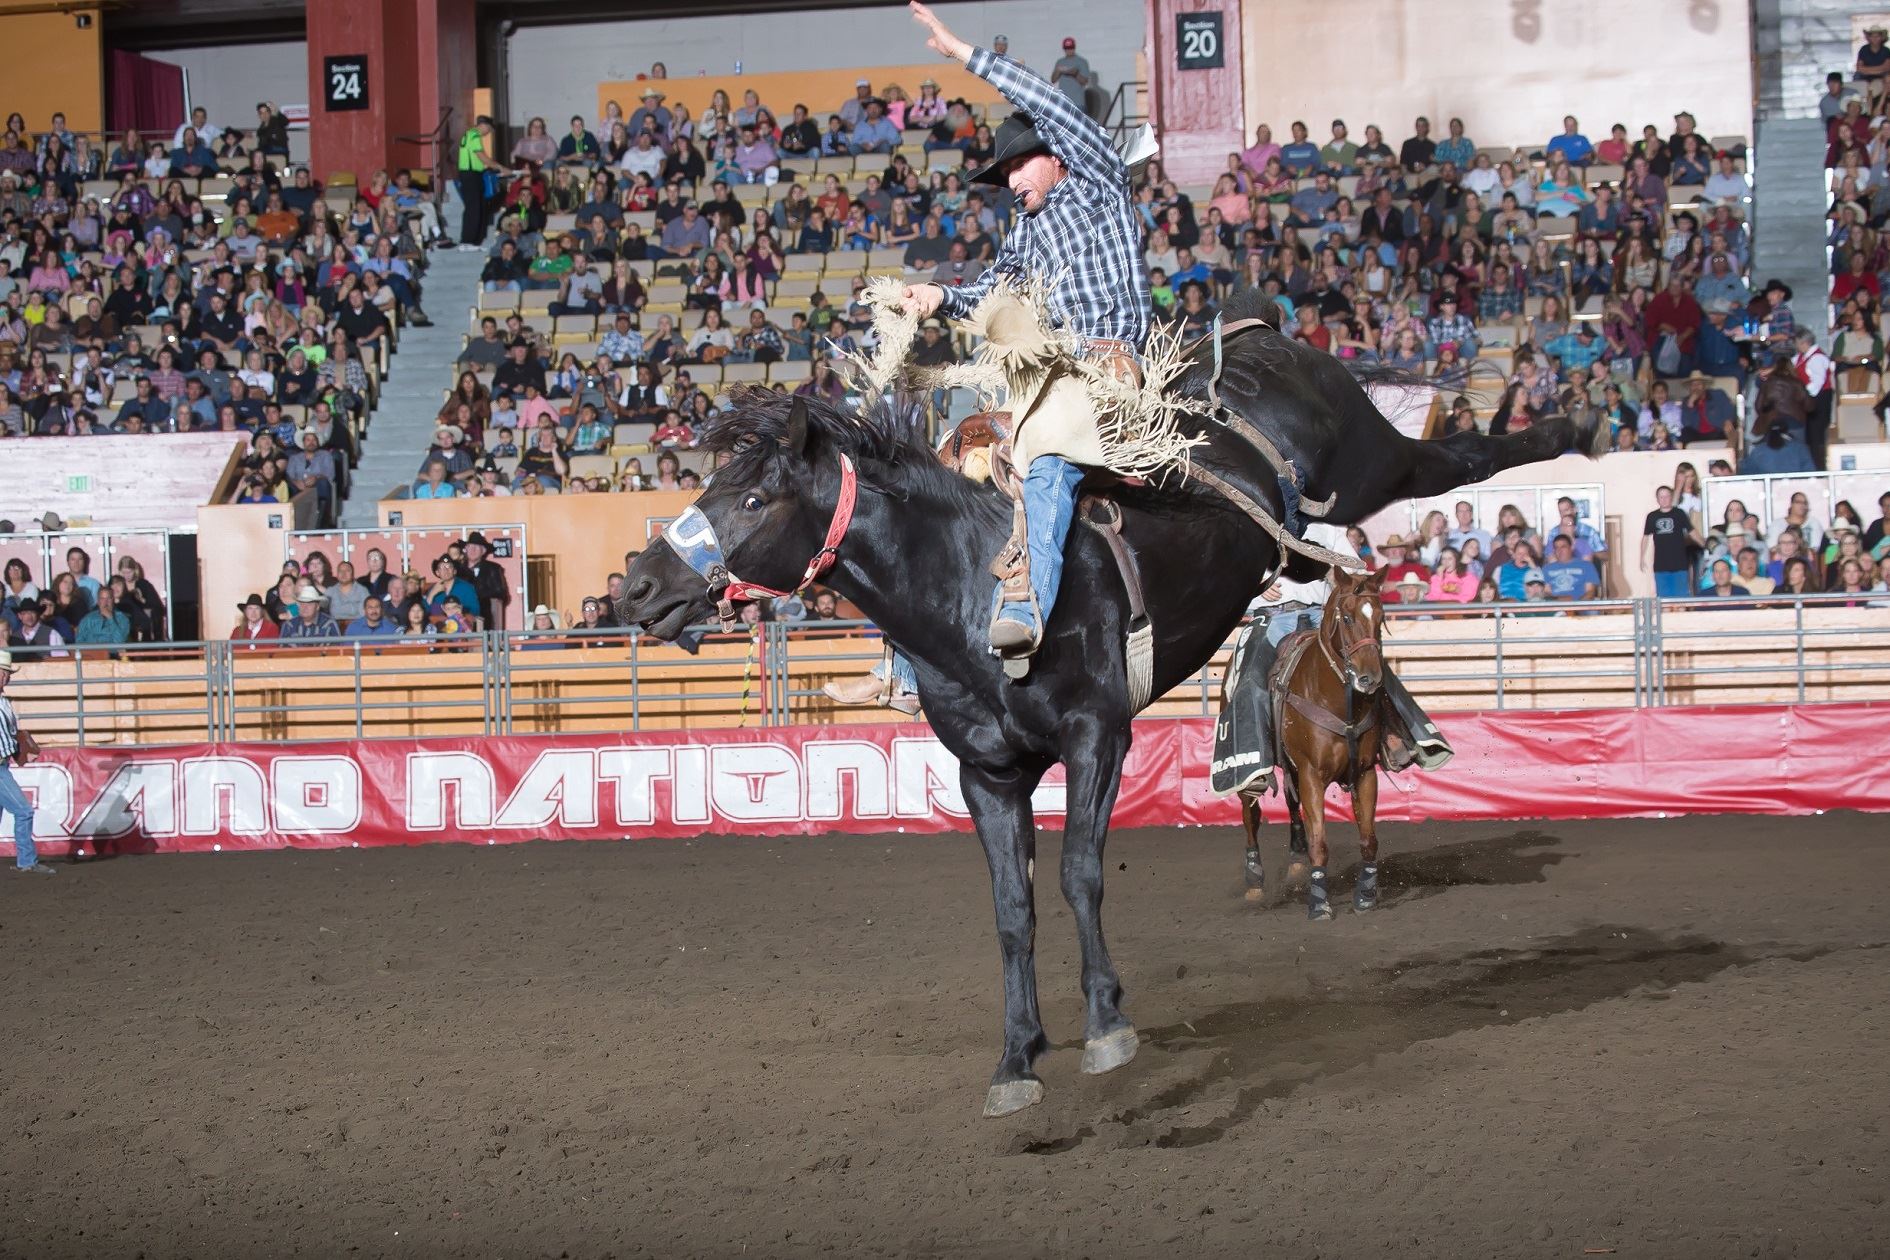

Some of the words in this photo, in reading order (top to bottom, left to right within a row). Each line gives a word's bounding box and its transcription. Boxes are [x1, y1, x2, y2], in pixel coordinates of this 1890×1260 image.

[1184, 30, 1216, 59] 20
[332, 73, 361, 100] 24
[1213, 752, 1260, 774] RAM
